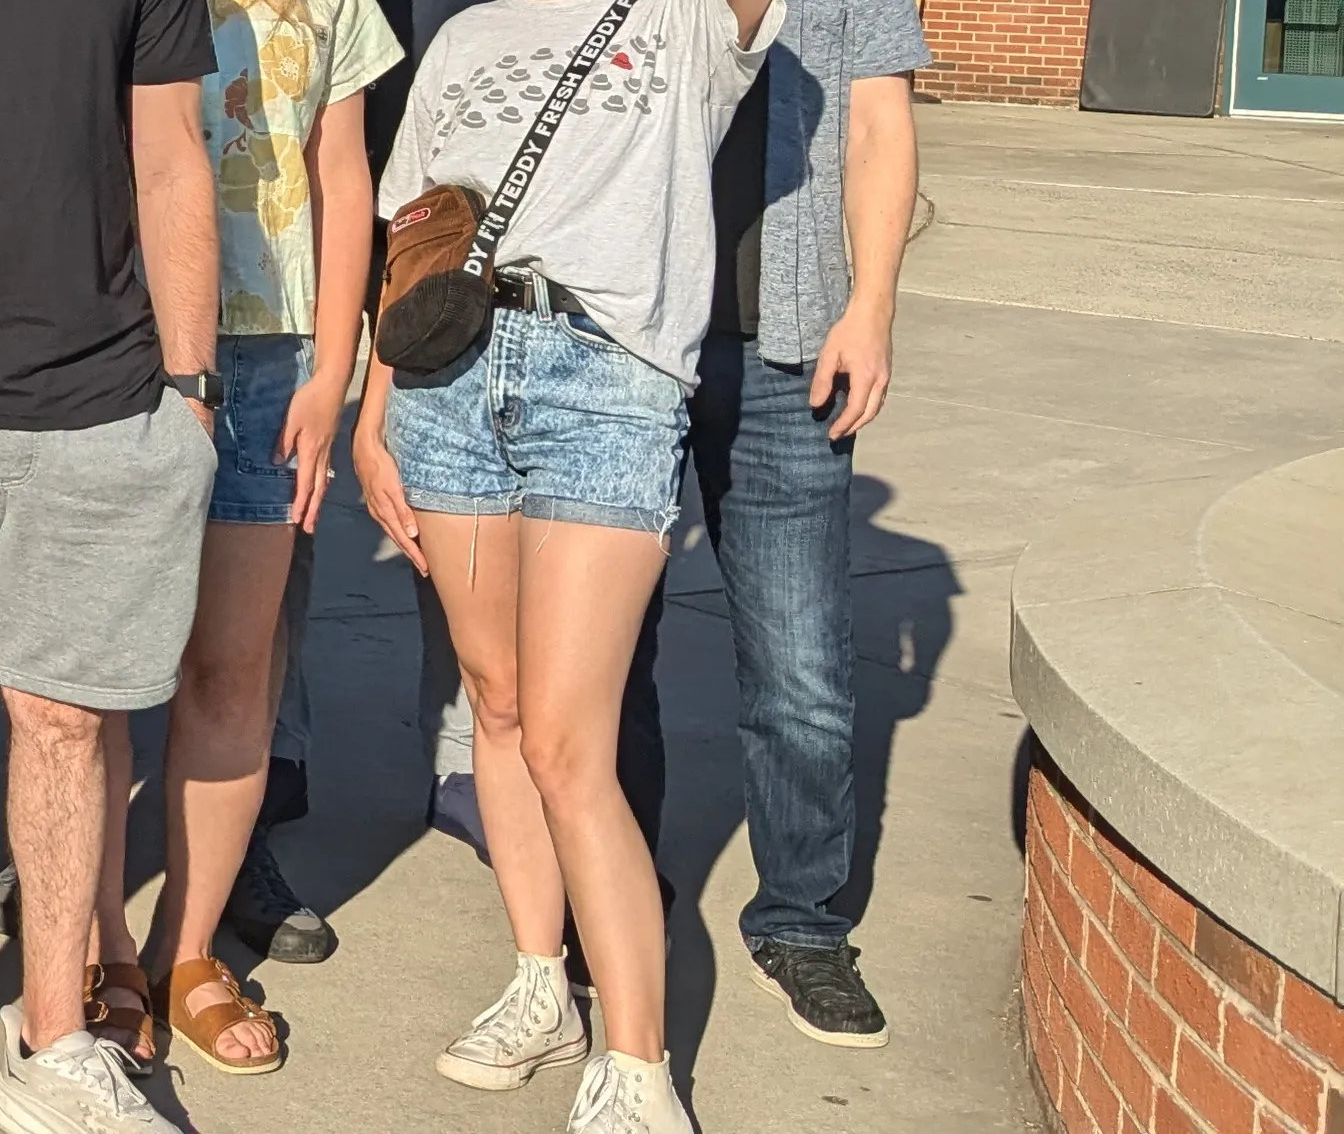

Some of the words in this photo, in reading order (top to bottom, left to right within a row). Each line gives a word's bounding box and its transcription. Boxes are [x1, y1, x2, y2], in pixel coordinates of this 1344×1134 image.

[495, 139, 543, 209] TEDDY
[535, 72, 583, 137] FRESH
[573, 8, 624, 71] TEDDY
